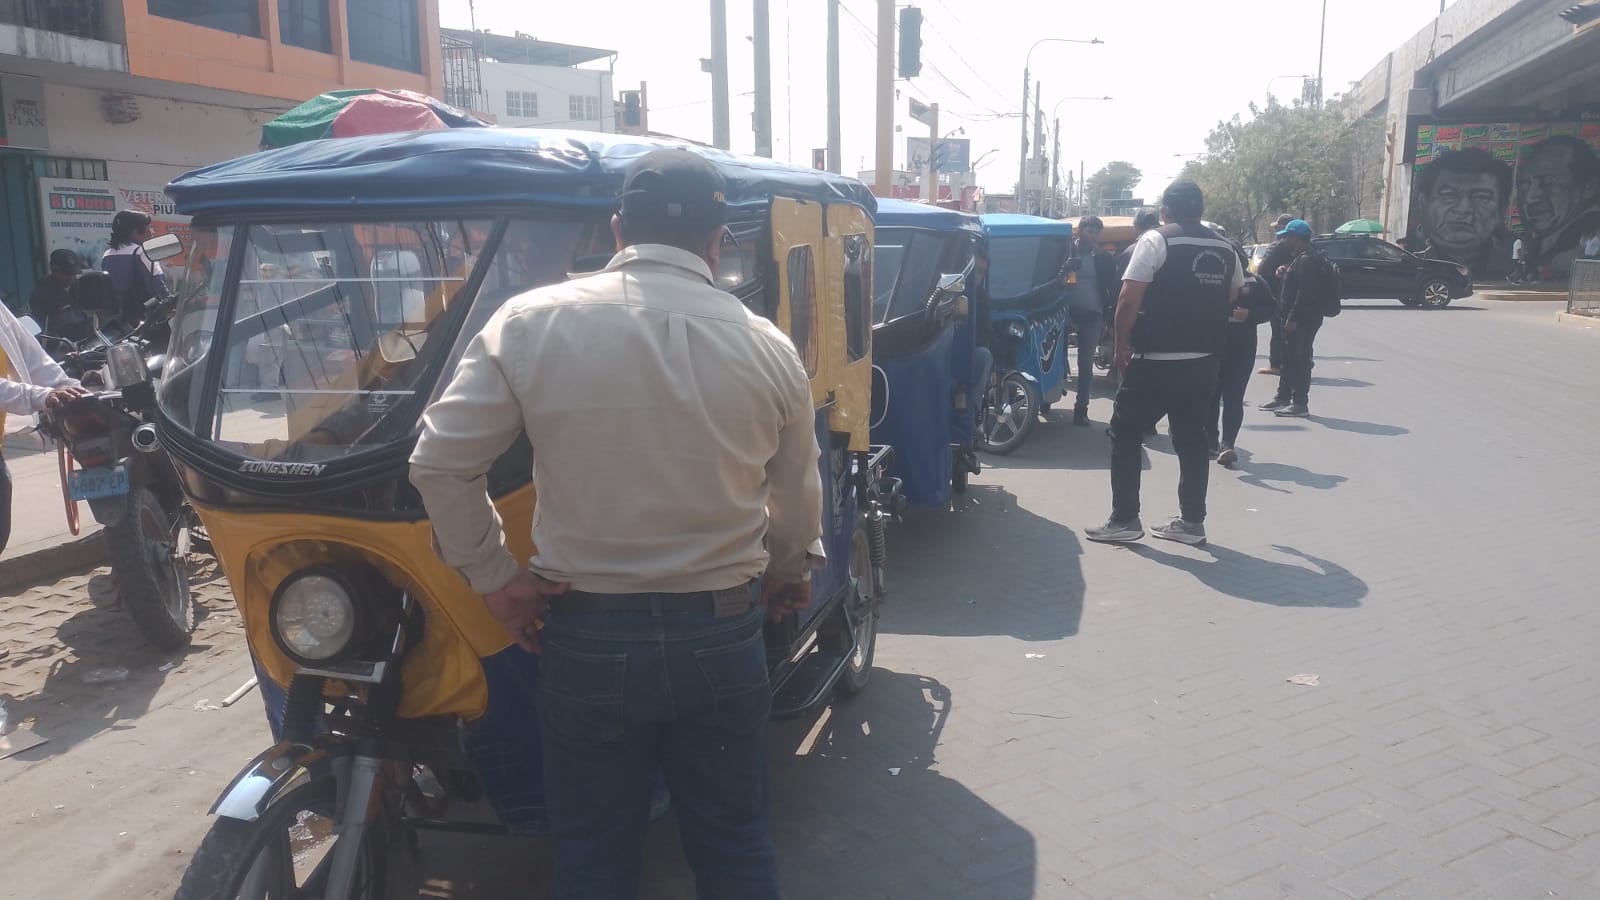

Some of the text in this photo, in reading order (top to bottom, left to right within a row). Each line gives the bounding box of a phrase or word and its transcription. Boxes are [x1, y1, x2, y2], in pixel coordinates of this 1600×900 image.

[14, 104, 40, 117] PRO
[7, 112, 46, 127] PLAN
[153, 204, 176, 215] PIU
[238, 460, 328, 476] ZONGSHEN
